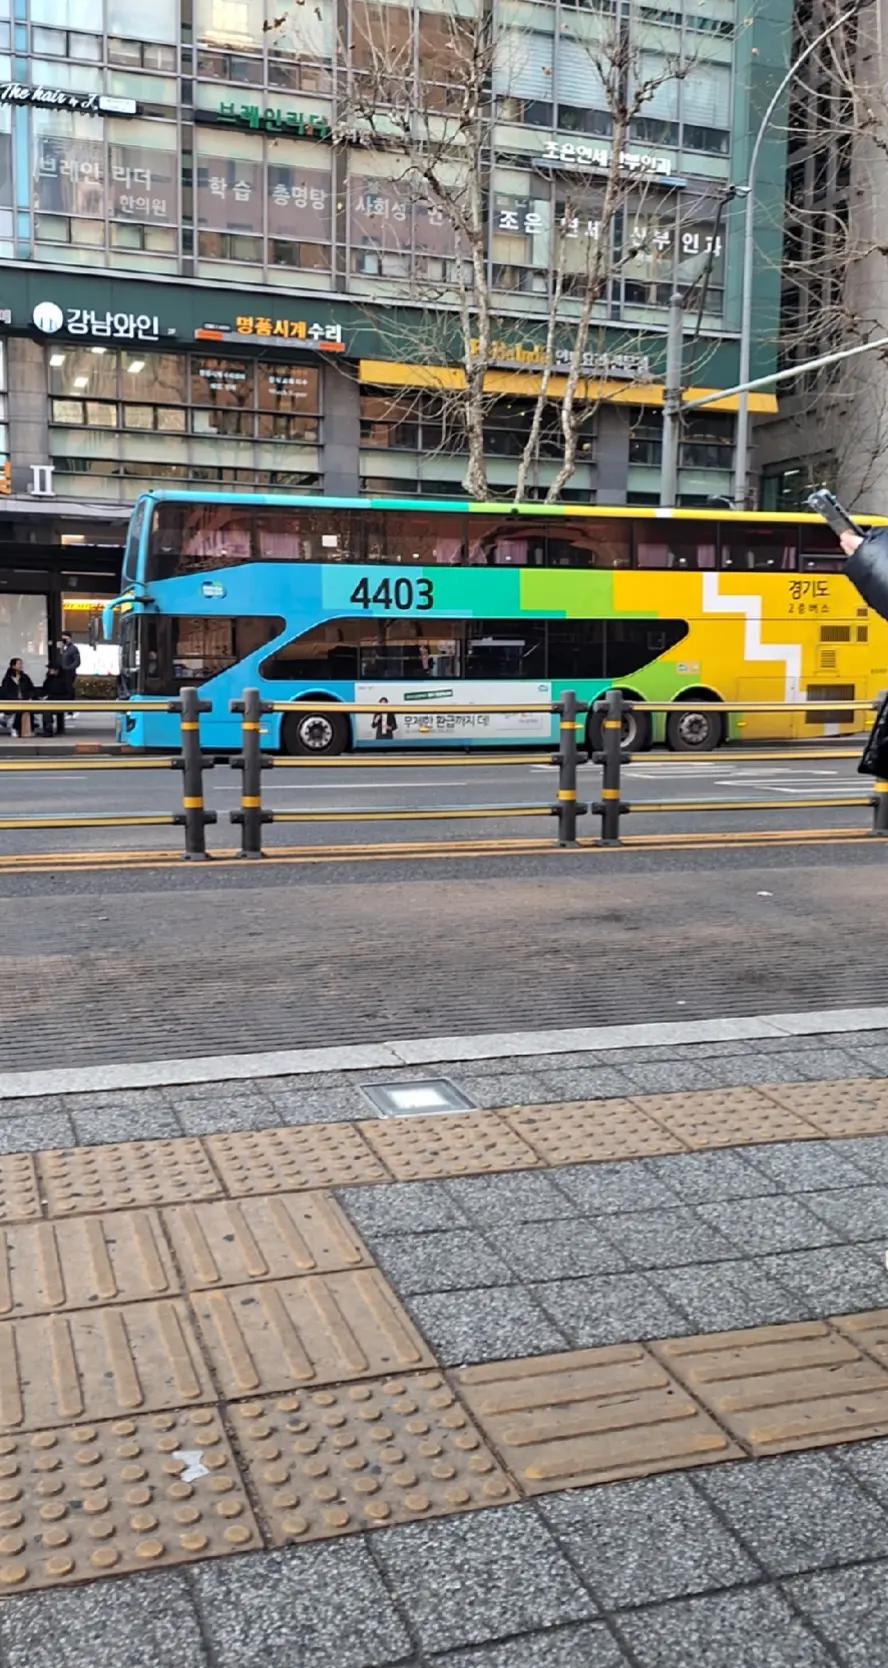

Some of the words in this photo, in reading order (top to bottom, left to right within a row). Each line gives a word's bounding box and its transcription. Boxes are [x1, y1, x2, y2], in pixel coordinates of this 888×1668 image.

[0, 83, 30, 99] The
[31, 86, 67, 104] hair
[38, 157, 99, 184] 브레인
[112, 164, 152, 191] 리더
[118, 194, 167, 217] 한의원
[271, 183, 328, 210] 총명탕
[498, 209, 543, 234] 조은
[66, 308, 160, 341] 강남와인
[350, 577, 434, 610] 4403
[788, 580, 831, 600] 경기도
